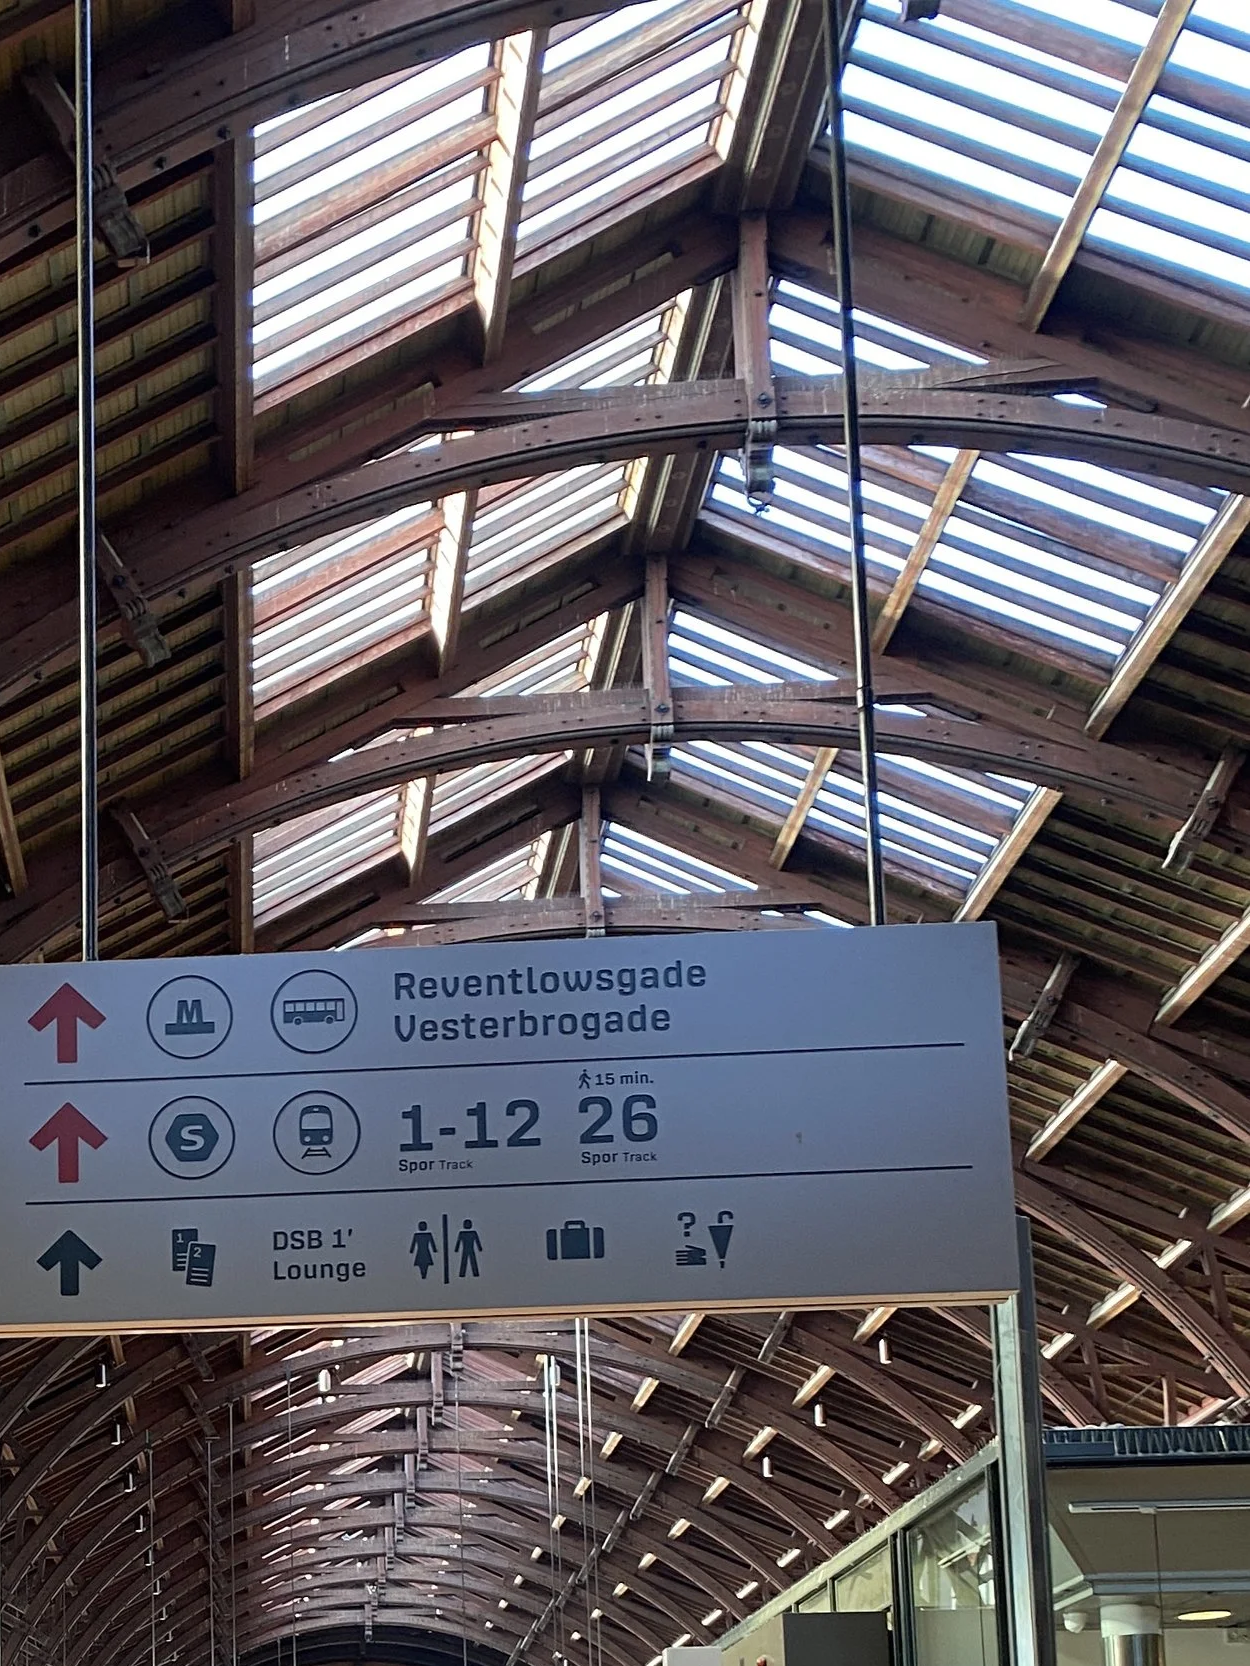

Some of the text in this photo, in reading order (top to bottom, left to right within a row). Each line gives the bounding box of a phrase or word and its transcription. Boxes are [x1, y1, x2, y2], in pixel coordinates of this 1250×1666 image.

[394, 960, 707, 1000] Reventlowsgade
[394, 1004, 671, 1042] Vesterbrogade
[595, 1070, 655, 1086] 15 min.
[400, 1094, 659, 1152] 1-12 26
[398, 1158, 474, 1174] Spor Track
[581, 1150, 658, 1165] Spor Track
[273, 1229, 323, 1251] DSB
[273, 1260, 366, 1283] Lounge
